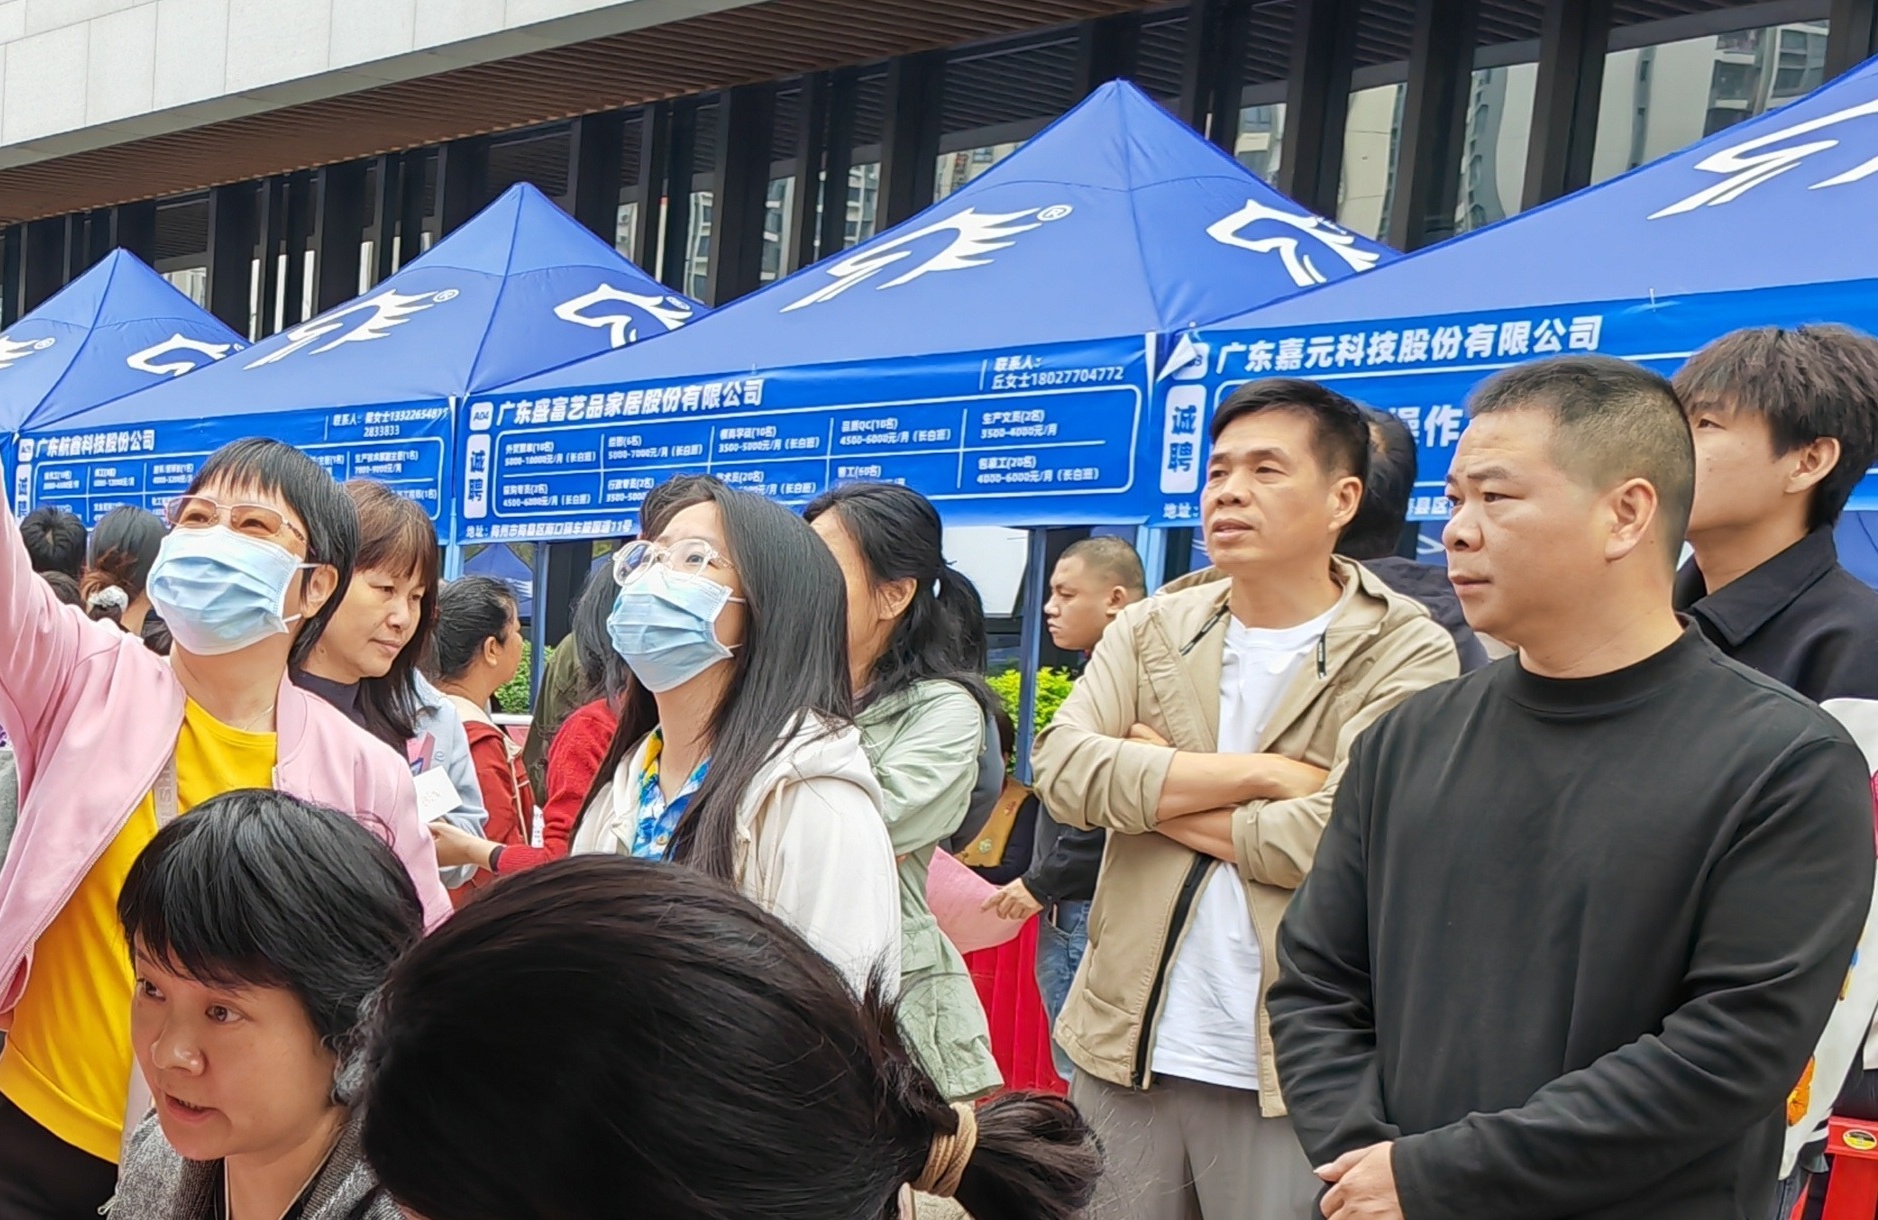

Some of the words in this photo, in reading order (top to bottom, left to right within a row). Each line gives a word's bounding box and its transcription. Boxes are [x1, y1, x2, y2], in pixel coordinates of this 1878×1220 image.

[1216, 316, 1603, 374] 广东嘉元科技股份有限公司
[496, 379, 765, 426] 广东盛富艺品家居股份有限公司
[992, 366, 1125, 390] 丘女士18027704772
[1167, 405, 1199, 473] 诚聘
